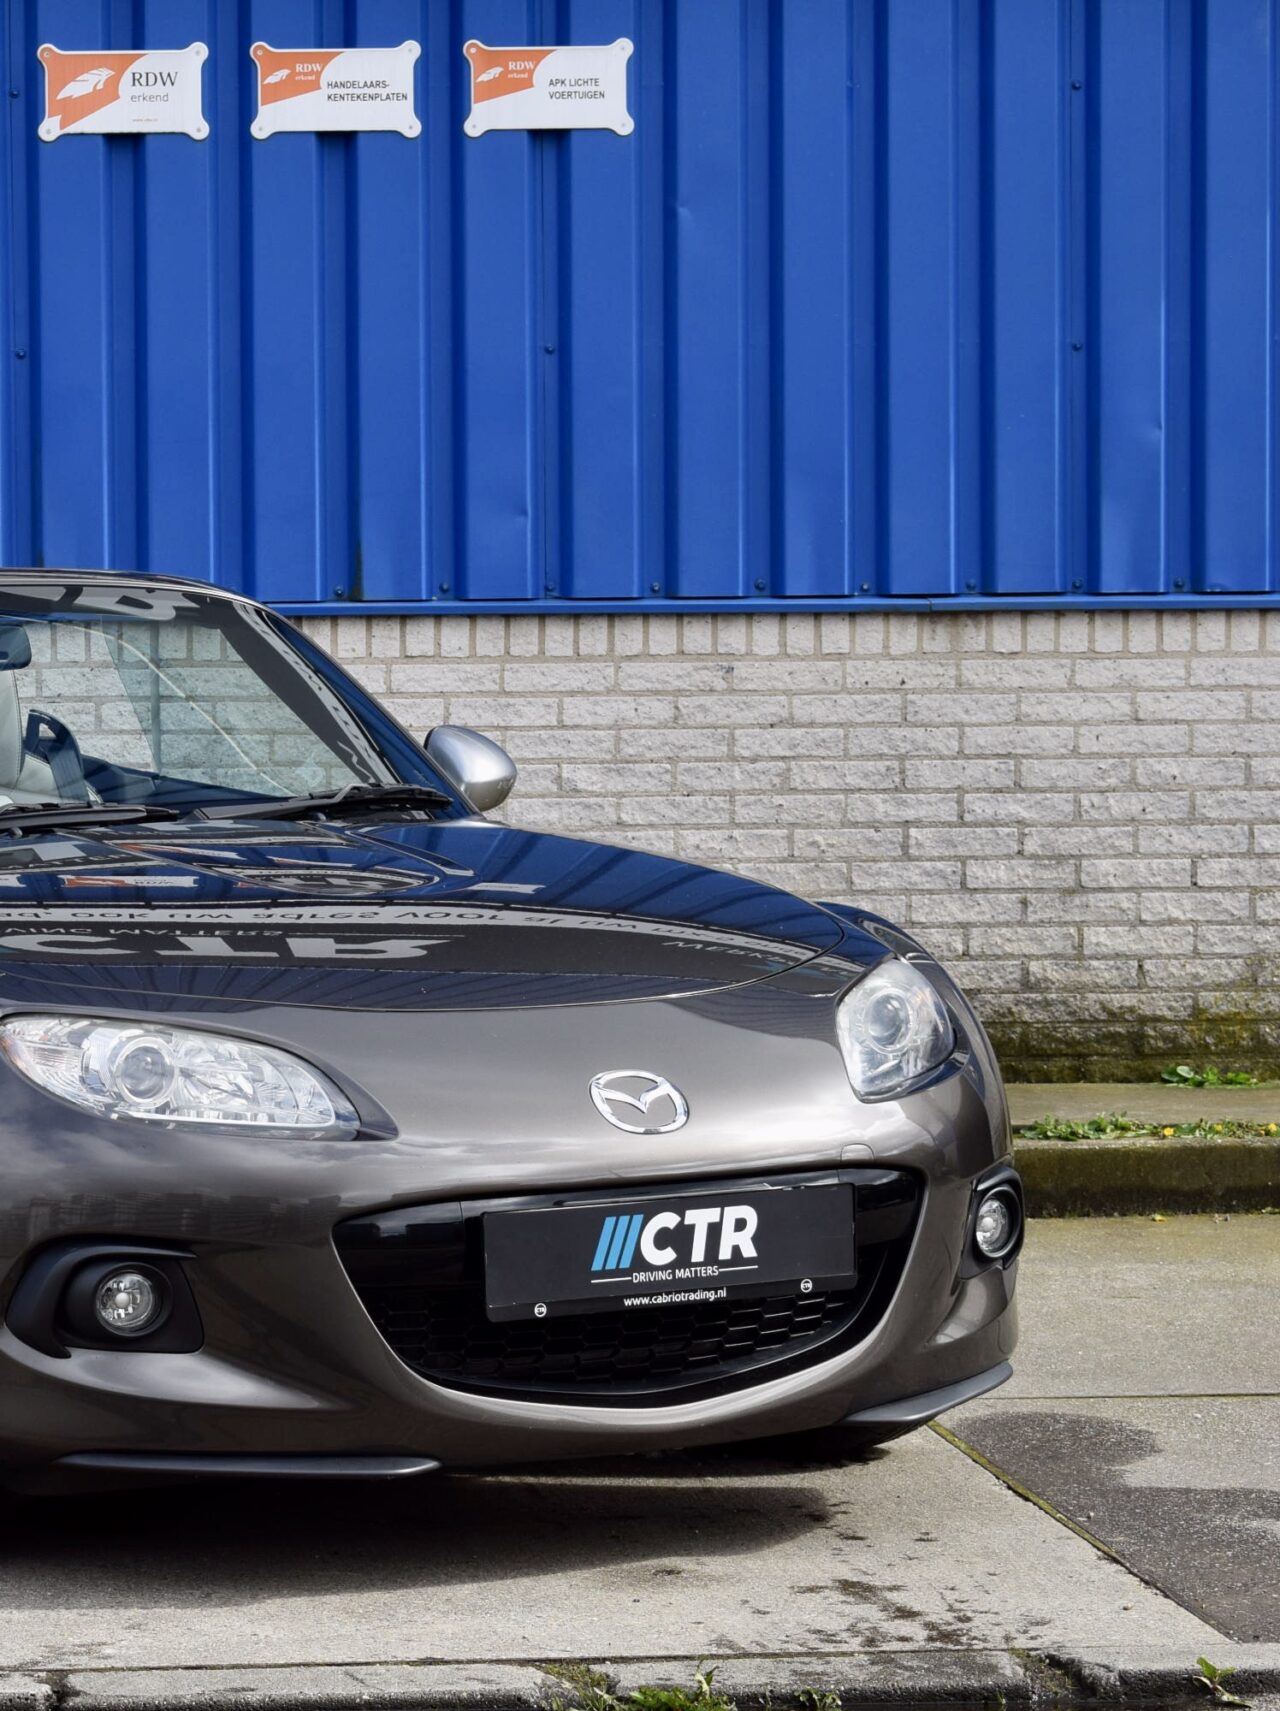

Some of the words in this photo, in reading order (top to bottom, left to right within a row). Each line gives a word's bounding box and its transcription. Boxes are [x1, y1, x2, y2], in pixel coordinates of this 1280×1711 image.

[295, 63, 322, 73] RDW
[508, 61, 535, 71] RDW
[131, 71, 178, 87] RDW
[548, 78, 567, 87] APK
[569, 78, 600, 87] LICHTE
[327, 80, 390, 89] HANDELAARS-
[130, 92, 169, 103] erkend
[327, 92, 408, 102] KENTEKENPLATEN
[548, 90, 605, 100] VOERTUIGEN
[640, 1205, 758, 1266] CTR
[632, 1269, 673, 1283] DRIVING
[675, 1265, 719, 1279] MATTERS
[623, 1286, 727, 1307] www.cabriotrading.nl
